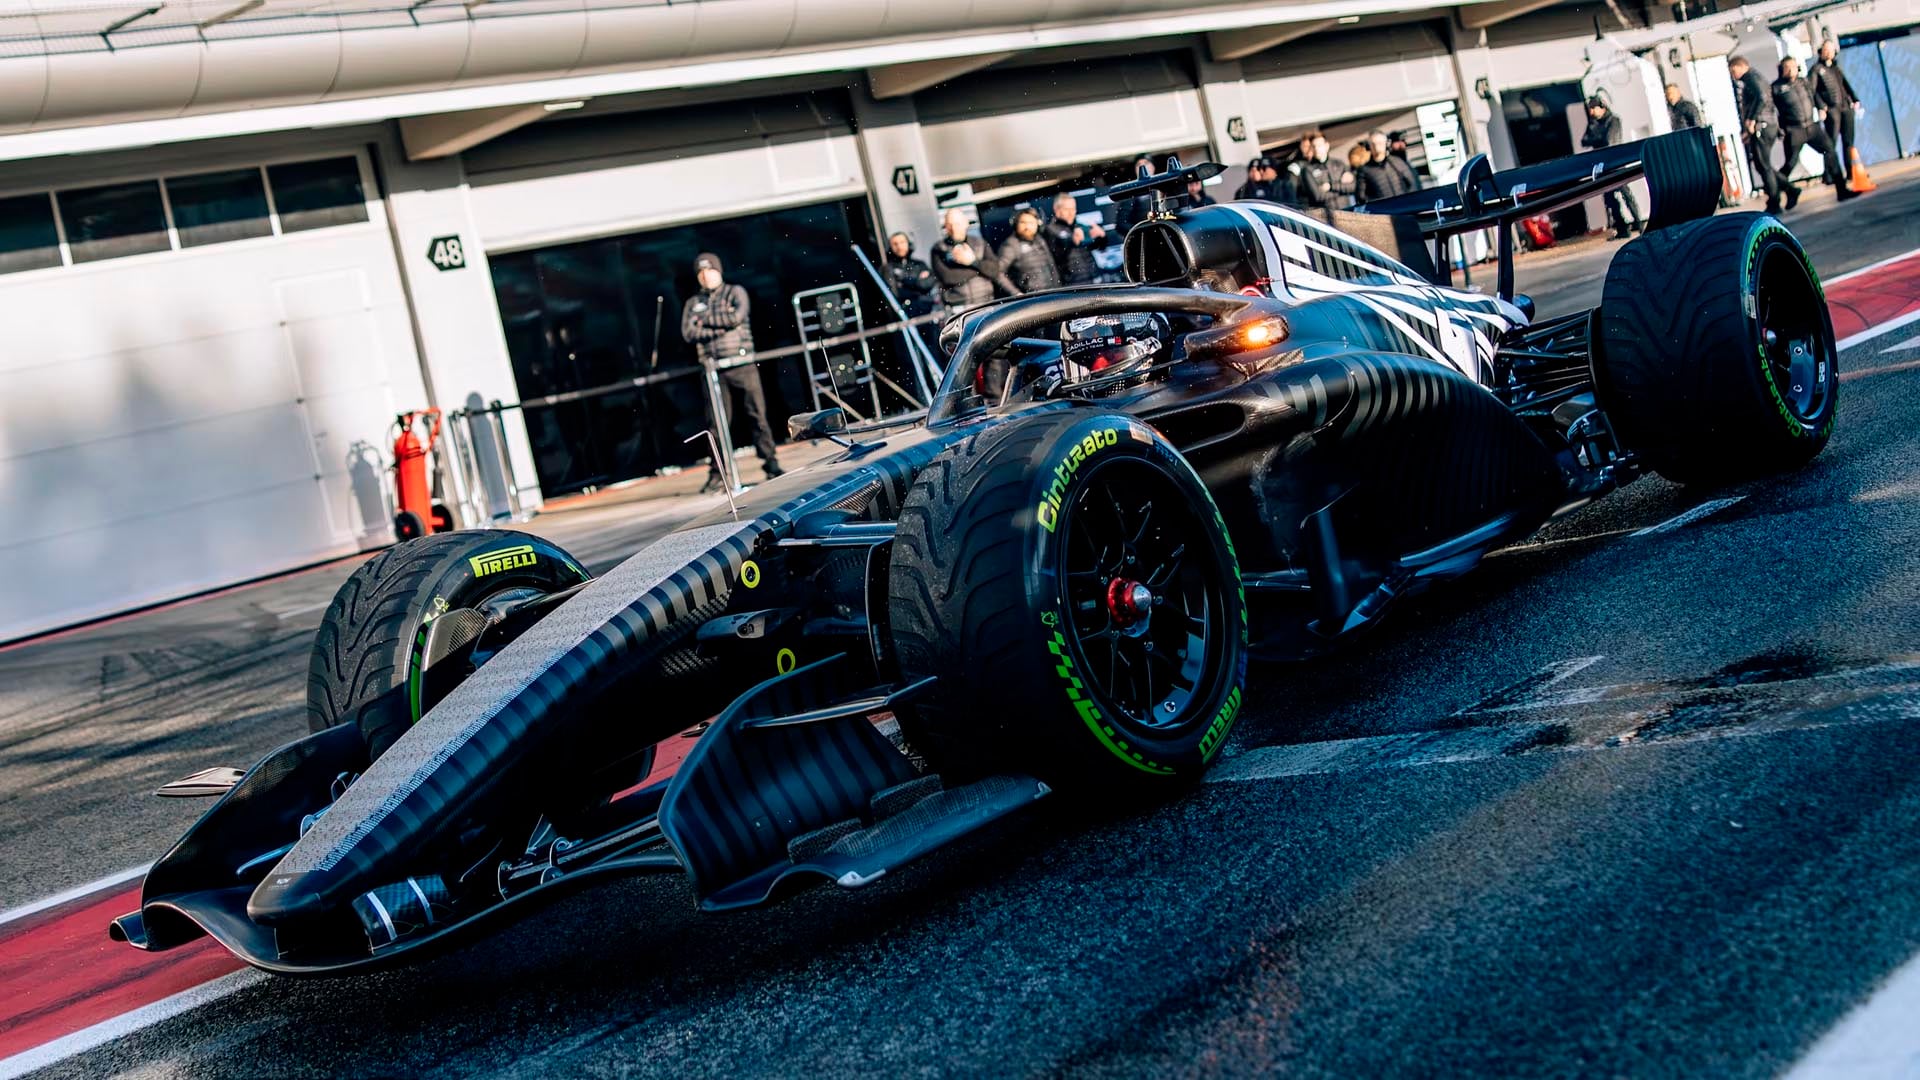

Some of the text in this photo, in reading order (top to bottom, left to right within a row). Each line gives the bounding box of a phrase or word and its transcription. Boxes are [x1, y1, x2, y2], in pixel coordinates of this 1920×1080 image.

[896, 169, 915, 192] 47
[433, 239, 463, 267] 48
[1066, 337, 1104, 353] CADILLAC
[1037, 428, 1118, 533] Cinturato
[468, 544, 538, 578] PIRELLI
[1198, 685, 1242, 765] PIRELLI
